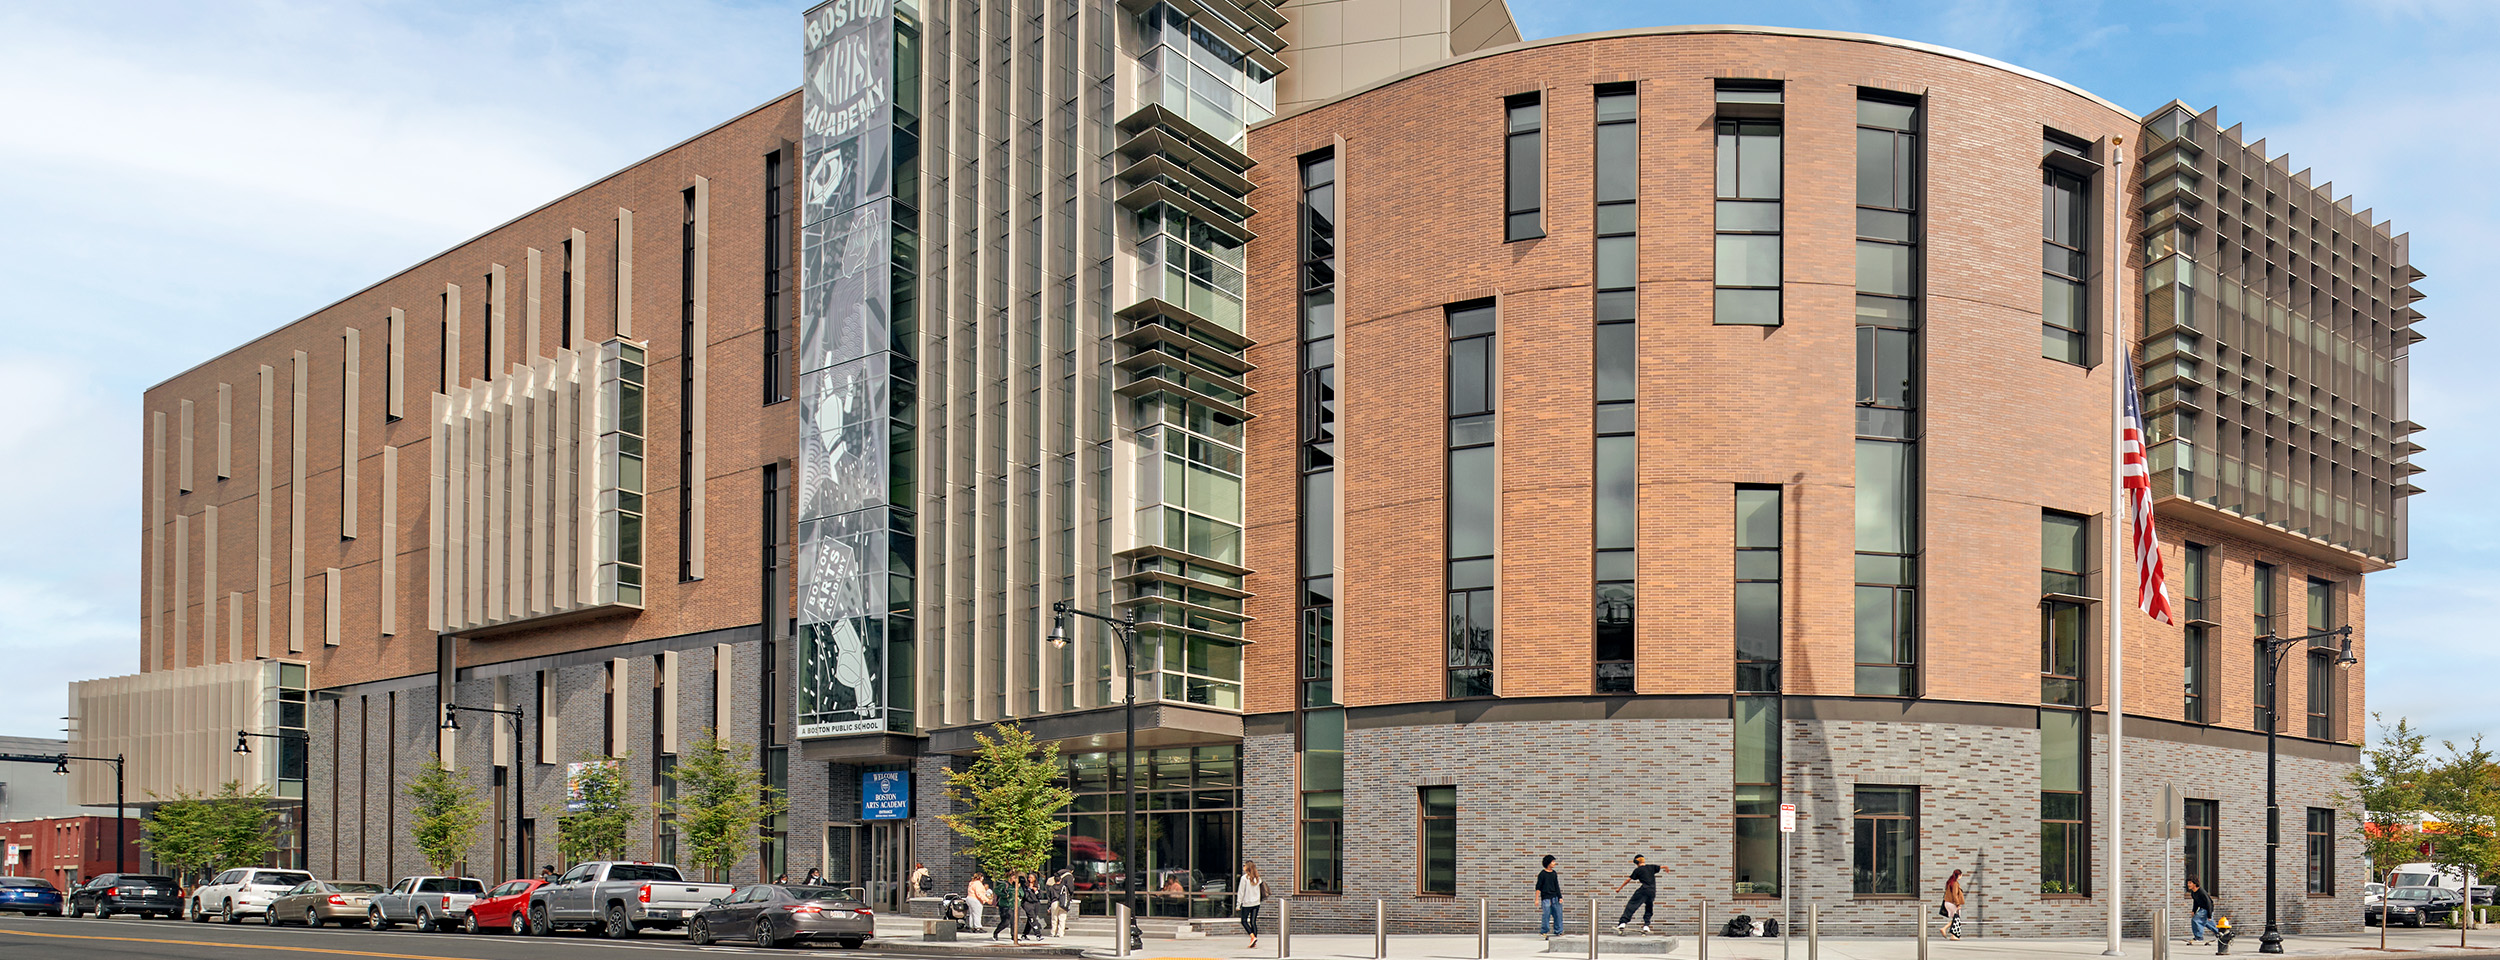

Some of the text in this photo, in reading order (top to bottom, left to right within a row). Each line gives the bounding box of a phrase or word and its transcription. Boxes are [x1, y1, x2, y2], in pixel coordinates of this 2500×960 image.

[807, 0, 885, 49] BOSTON
[804, 77, 885, 136] ACADEMY
[808, 544, 831, 606] BOSTON
[818, 549, 840, 612] ARTS
[807, 726, 830, 734] BOSTON
[832, 724, 852, 732] PUBLIC
[854, 722, 878, 731] SCHOOL
[873, 772, 898, 781] WELCOME
[875, 793, 896, 801] BOSTON
